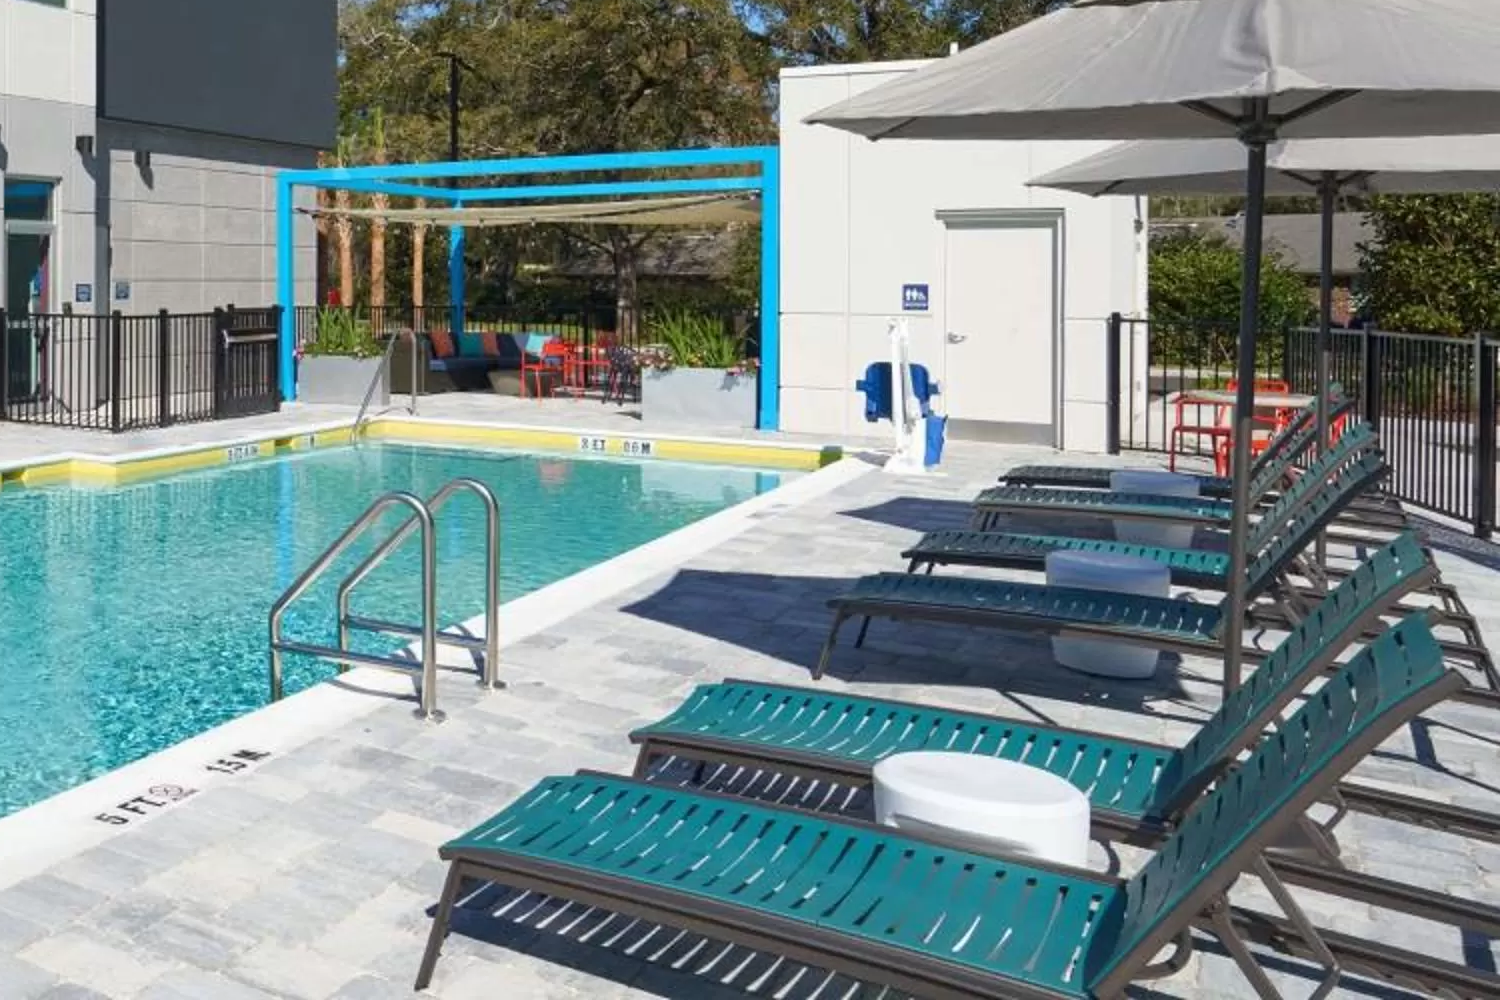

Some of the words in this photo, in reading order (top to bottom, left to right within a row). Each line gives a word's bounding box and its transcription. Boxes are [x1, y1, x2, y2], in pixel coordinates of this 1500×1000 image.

[94, 813, 129, 825] 5
[116, 796, 167, 815] FT
[231, 749, 272, 762] M
